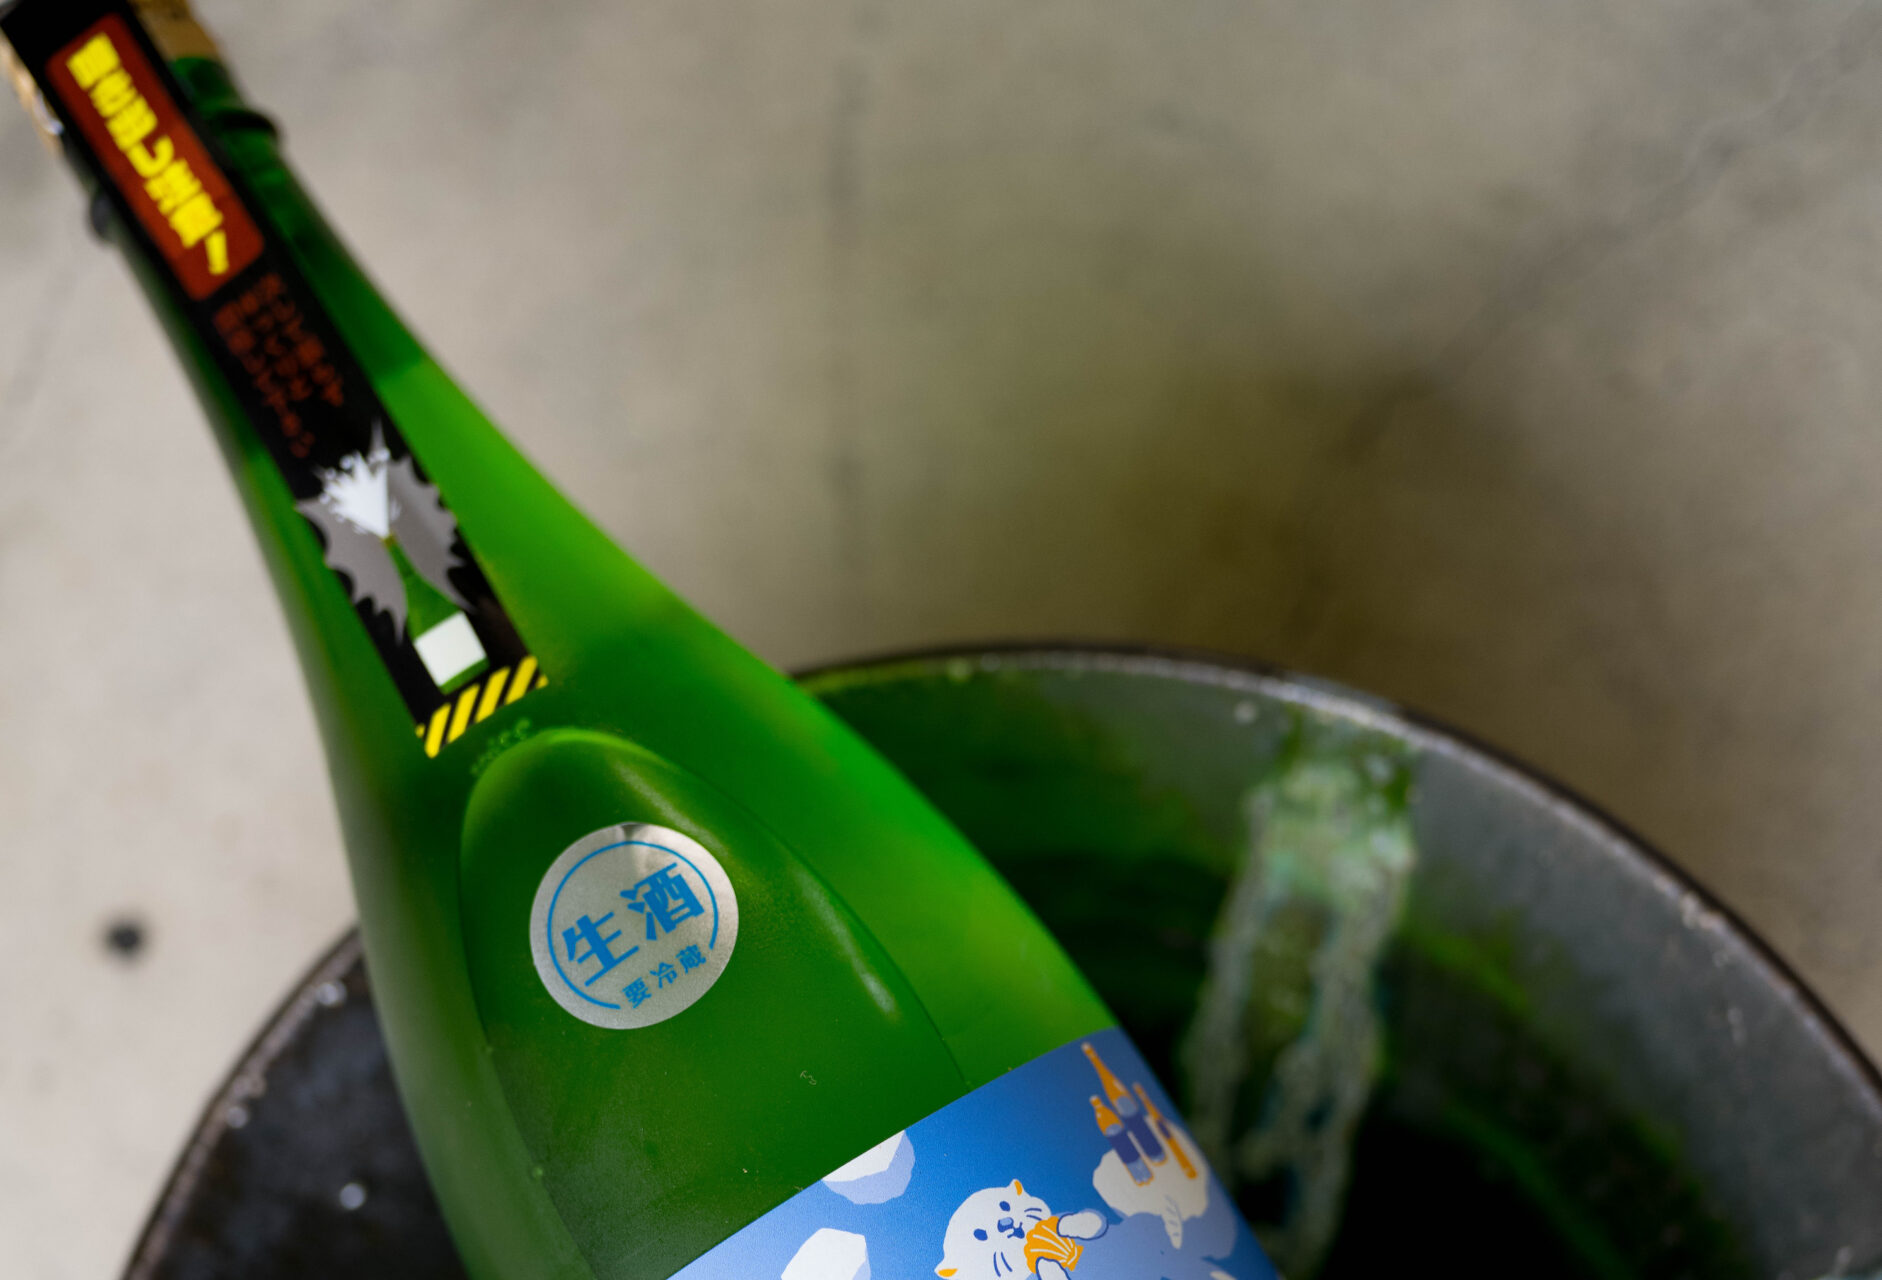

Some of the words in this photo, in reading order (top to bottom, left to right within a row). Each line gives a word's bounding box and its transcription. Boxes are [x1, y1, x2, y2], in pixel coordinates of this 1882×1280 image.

[562, 863, 705, 988] 生酒
[622, 943, 707, 1009] 要冷蔵
